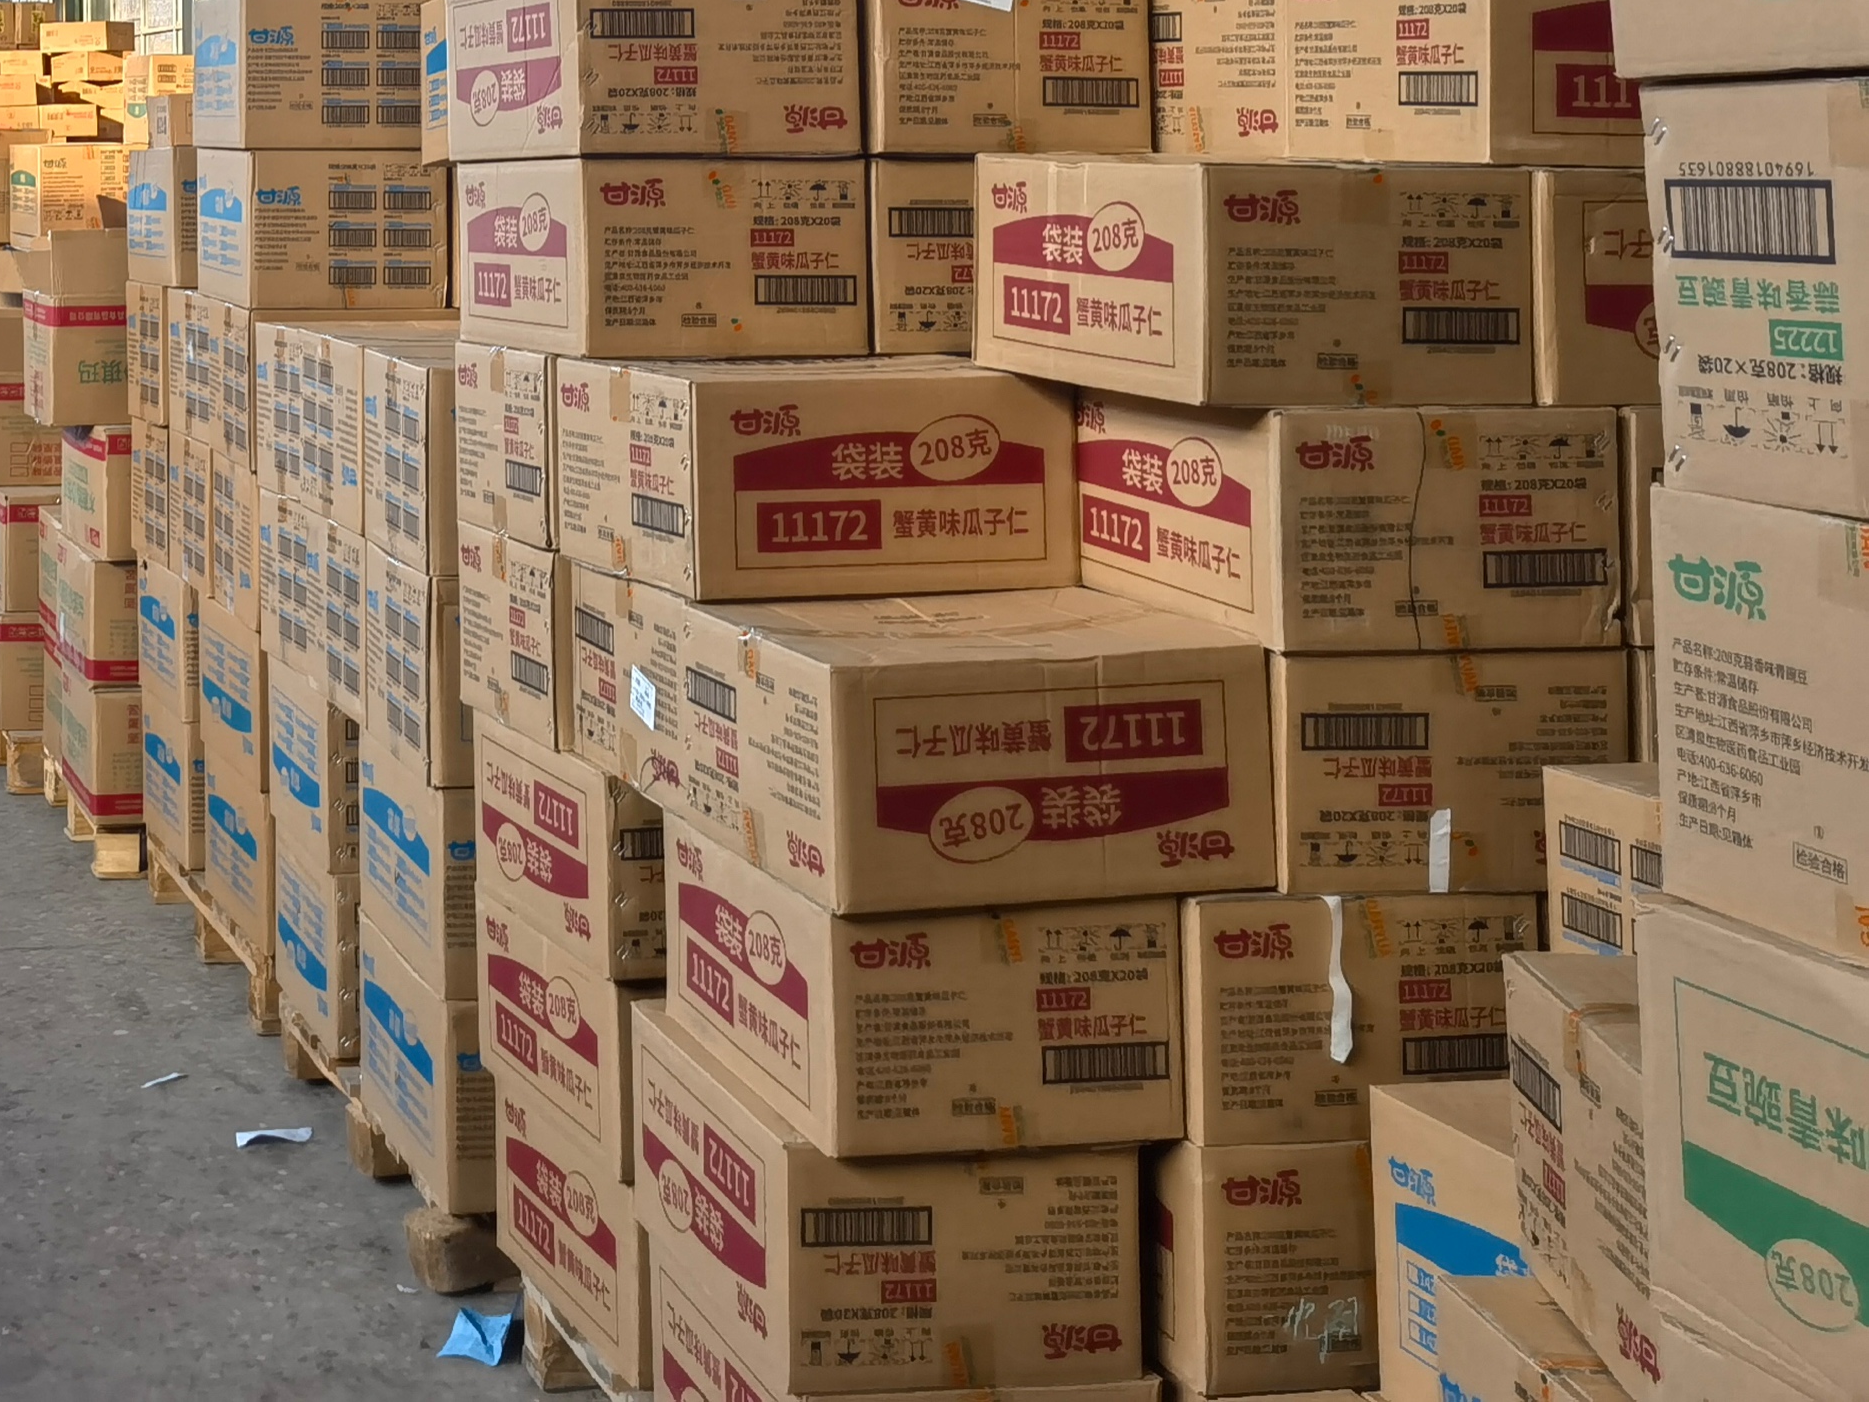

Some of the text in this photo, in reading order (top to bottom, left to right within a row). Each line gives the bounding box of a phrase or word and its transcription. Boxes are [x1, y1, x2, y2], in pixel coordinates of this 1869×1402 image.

[248, 25, 294, 46] 甘源
[459, 11, 547, 51] 11172 蟹黄味瓜子仁
[1042, 35, 1079, 48] 11172
[1398, 22, 1428, 38] 11172
[608, 43, 698, 62] 蟹黄味瓜子仁
[1039, 54, 1125, 74] 蟹黄味瓜子仁
[1395, 43, 1464, 67] 蟹黄味瓜子仁
[473, 69, 527, 115] 袋装 208克
[656, 68, 697, 84] 11172
[536, 105, 564, 135] 甘源
[785, 105, 849, 134] 甘源
[1236, 106, 1279, 137] 甘源
[1678, 161, 1815, 177] 16940188801635
[256, 186, 302, 206] 甘源
[465, 182, 486, 209] 甘源
[599, 177, 667, 209] 甘源
[991, 181, 1028, 214] 甘源
[1224, 190, 1301, 225] 甘源
[494, 206, 549, 248] 袋装 208克
[753, 230, 792, 246] 11172
[1042, 218, 1139, 265] 袋装 208克
[751, 251, 839, 272] 蟹黄味瓜子仁
[1402, 255, 1447, 272] 11172
[478, 270, 562, 304] 11172 蟹黄味瓜子仁
[1399, 278, 1501, 302] 蟹黄味瓜子仁
[1675, 275, 1841, 314] 蒜香味青豌豆
[1010, 287, 1163, 337] 11172 蟹黄味瓜子仁
[1774, 326, 1839, 354] 12225
[560, 382, 590, 413] 甘源
[730, 404, 801, 437] 甘源
[630, 445, 651, 464] 11172
[831, 428, 992, 480] 袋装 208克
[1295, 436, 1375, 472] 甘源
[630, 469, 675, 496] 蟹黄味瓜子仁
[1122, 448, 1218, 495] 袋装 208克
[1482, 498, 1531, 513] 11172
[771, 507, 1029, 543] 11172 蟹黄味瓜子仁
[1479, 522, 1588, 545] 蟹黄味瓜子仁
[1090, 507, 1143, 551] 11172
[1156, 525, 1241, 580] 蟹黄味瓜子仁
[1667, 553, 1767, 621] 甘源
[896, 712, 1186, 758] 11172 蟹黄味瓜子仁
[1323, 756, 1433, 780] 蟹黄味瓜子仁
[1381, 786, 1430, 804] 11172
[538, 791, 574, 837] 11172
[939, 784, 1122, 849] 袋装 208克
[498, 836, 525, 866] 208克
[786, 830, 825, 877] 甘源
[1157, 830, 1235, 867] 甘源
[715, 903, 783, 968] 袋装 208克
[850, 932, 931, 970] 甘源
[1213, 923, 1294, 961] 甘源
[1040, 990, 1088, 1008] 11172
[1403, 983, 1449, 999] 11172
[548, 996, 578, 1025] 208克
[691, 952, 730, 1011] 11172
[738, 993, 801, 1071] 蟹黄味瓜子仁
[501, 1012, 534, 1064] 11172
[708, 1136, 750, 1207] 11172
[1221, 1169, 1303, 1208] 甘源
[518, 1198, 551, 1254] 11172
[885, 1282, 932, 1299] 11172
[1771, 1248, 1854, 1308] 208克
